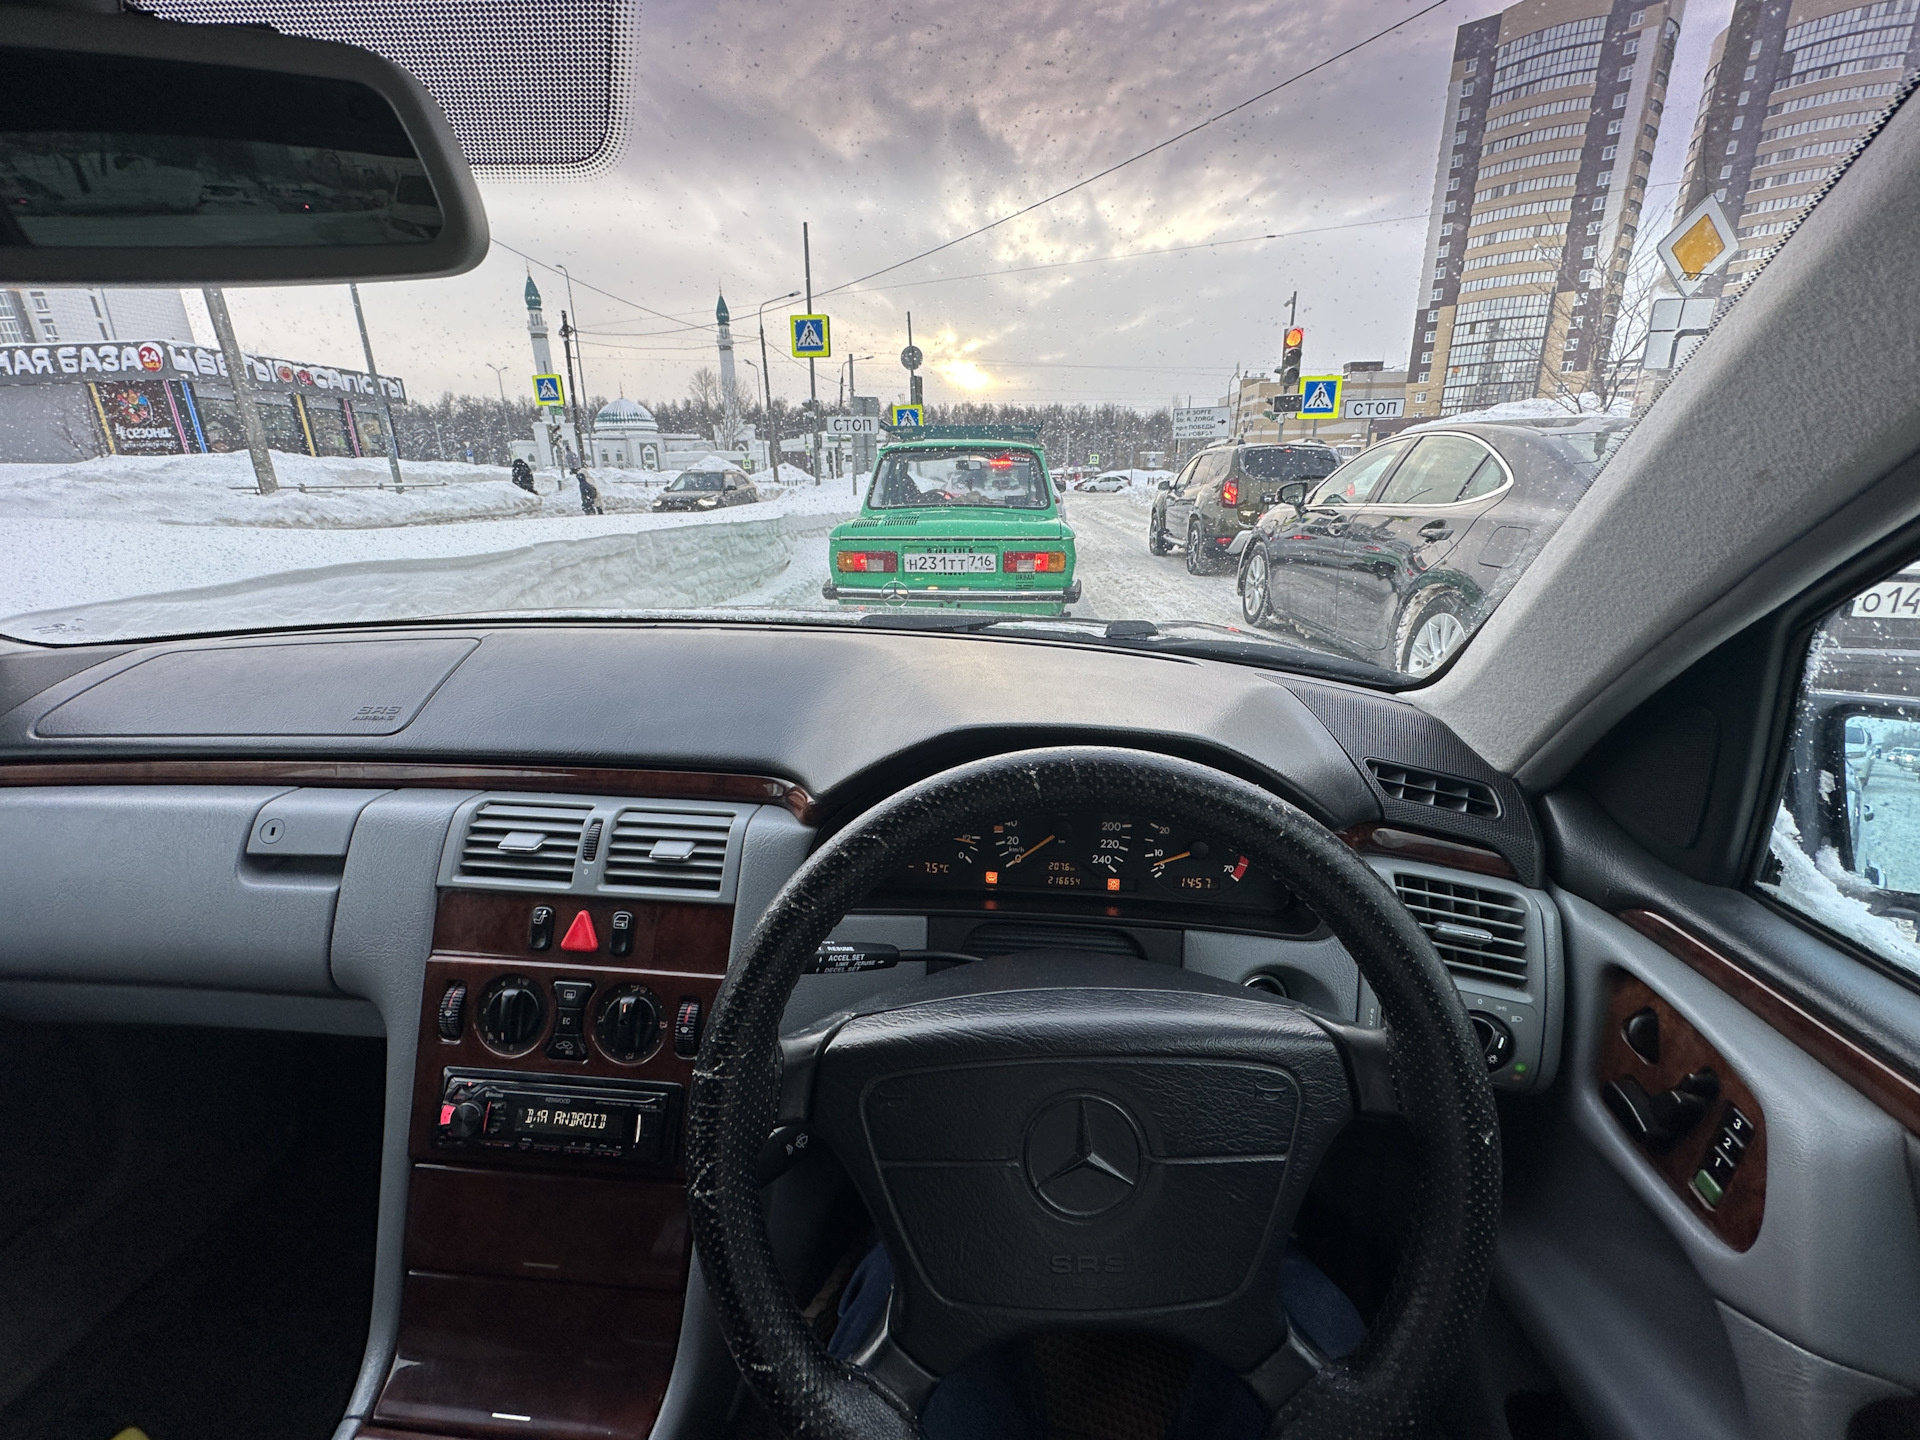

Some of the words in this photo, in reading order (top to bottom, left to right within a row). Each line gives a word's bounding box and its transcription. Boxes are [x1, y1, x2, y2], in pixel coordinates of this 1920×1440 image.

[57, 345, 143, 373] БАЗА
[141, 351, 159, 362] 24
[1353, 401, 1397, 416] СТОП
[833, 419, 872, 431] СТОП
[126, 426, 171, 439] сезона
[909, 556, 966, 570] Н231ТТ
[969, 555, 992, 566] 716
[357, 706, 402, 714] SRS
[1101, 822, 1121, 831] 200
[1159, 826, 1170, 835] 20
[1006, 836, 1019, 845] 20
[1100, 839, 1119, 849] 220
[958, 851, 964, 859] 0
[1154, 849, 1163, 857] 10
[1092, 855, 1112, 864] 240
[1223, 865, 1235, 873] 70
[1048, 876, 1081, 885] 216654
[1181, 877, 1212, 889] 14:57
[562, 1017, 571, 1025] EC
[554, 1110, 607, 1129] ANDROID
[1733, 1118, 1742, 1130] 3
[1722, 1137, 1732, 1150] 2
[1714, 1157, 1721, 1167] 1
[1049, 1255, 1127, 1275] SRS
